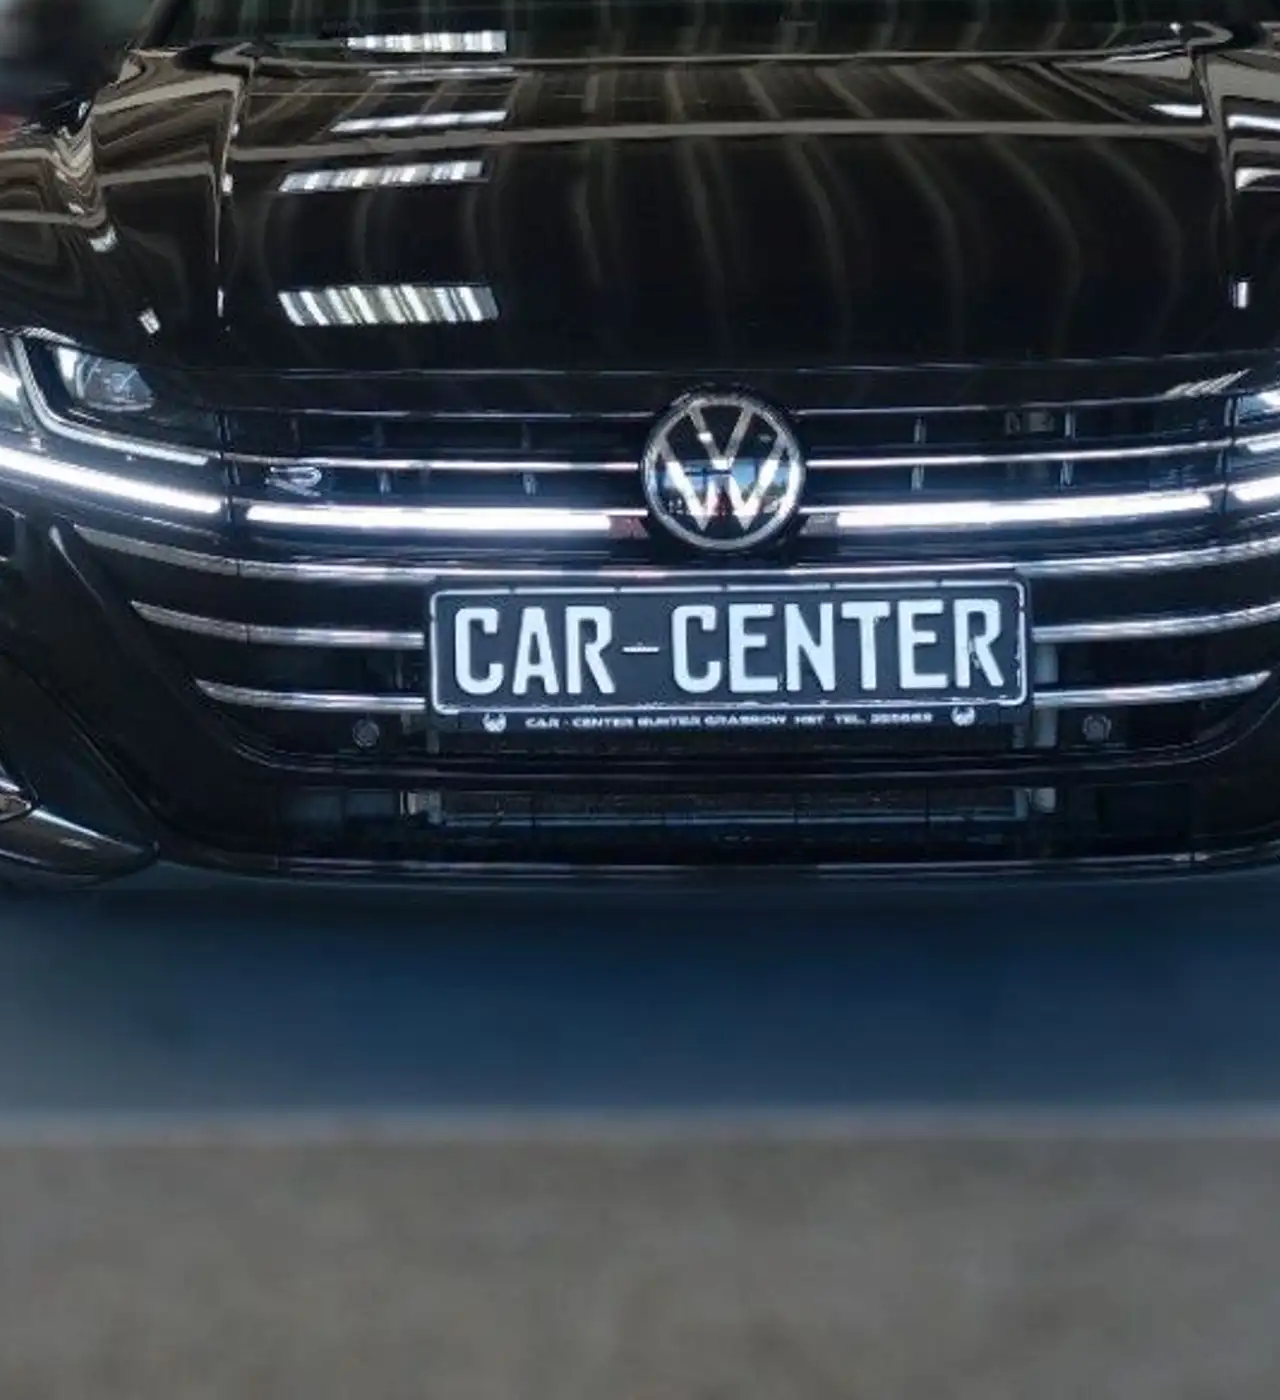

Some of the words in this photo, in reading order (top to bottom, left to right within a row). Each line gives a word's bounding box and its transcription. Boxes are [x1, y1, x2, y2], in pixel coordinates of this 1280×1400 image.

[646, 396, 800, 548] VW
[525, 716, 560, 729] CAR
[572, 715, 634, 728] CENTER
